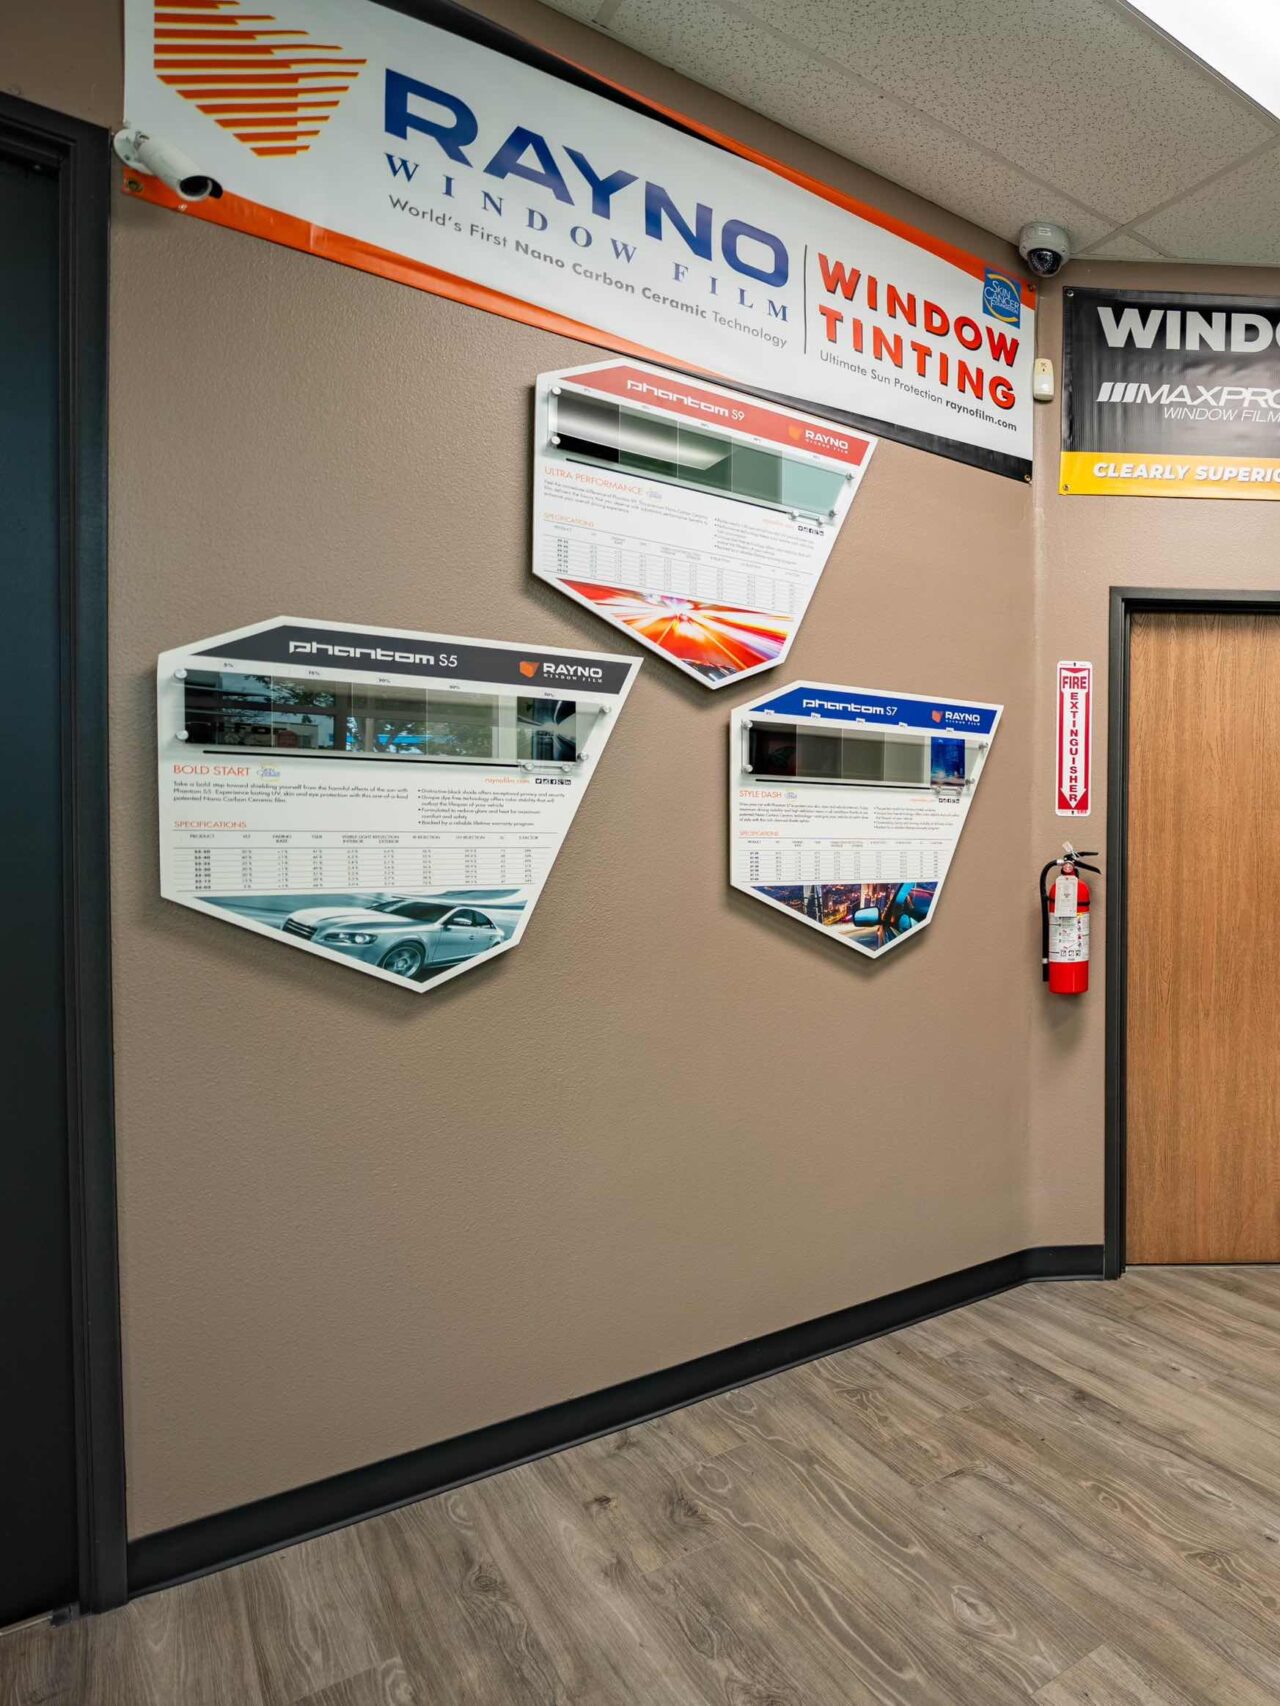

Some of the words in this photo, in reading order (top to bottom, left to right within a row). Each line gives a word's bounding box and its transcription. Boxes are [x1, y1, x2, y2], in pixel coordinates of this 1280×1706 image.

[385, 67, 789, 288] RAYNO
[385, 152, 637, 264] WINDOW
[672, 261, 789, 322] FILM
[470, 223, 507, 247] First
[514, 239, 565, 269] Nano
[572, 262, 635, 294] Carbon
[642, 287, 707, 319] Ceramic
[712, 310, 788, 349] Technology
[818, 252, 1019, 367] WINDOW
[818, 304, 1017, 410] TINTING
[626, 378, 729, 417] phantom
[732, 408, 745, 421] S9
[820, 350, 867, 377] Ultimate
[870, 369, 891, 385] Sun
[894, 377, 943, 404] Protection
[945, 399, 1018, 432] raynofilm.com
[1164, 407, 1238, 421] WINDOW
[805, 429, 848, 450] RAYNO
[544, 466, 573, 481] ULTRA
[575, 470, 643, 496] PERFORMANCE
[1093, 463, 1190, 480] CLEARLY
[288, 640, 435, 665] phantom
[438, 653, 458, 668] S5
[543, 662, 603, 678] RAYNO
[1062, 675, 1087, 689] FIRE
[802, 697, 885, 715] phantom
[885, 705, 898, 716] S7
[944, 710, 981, 722] RAYNO
[1069, 692, 1079, 802] EXTINGUISHER
[173, 764, 210, 775] BOLD
[213, 766, 250, 777] START
[738, 789, 759, 798] STYLE
[761, 790, 782, 799] DASH
[174, 820, 247, 829] SPECIFICATIONS
